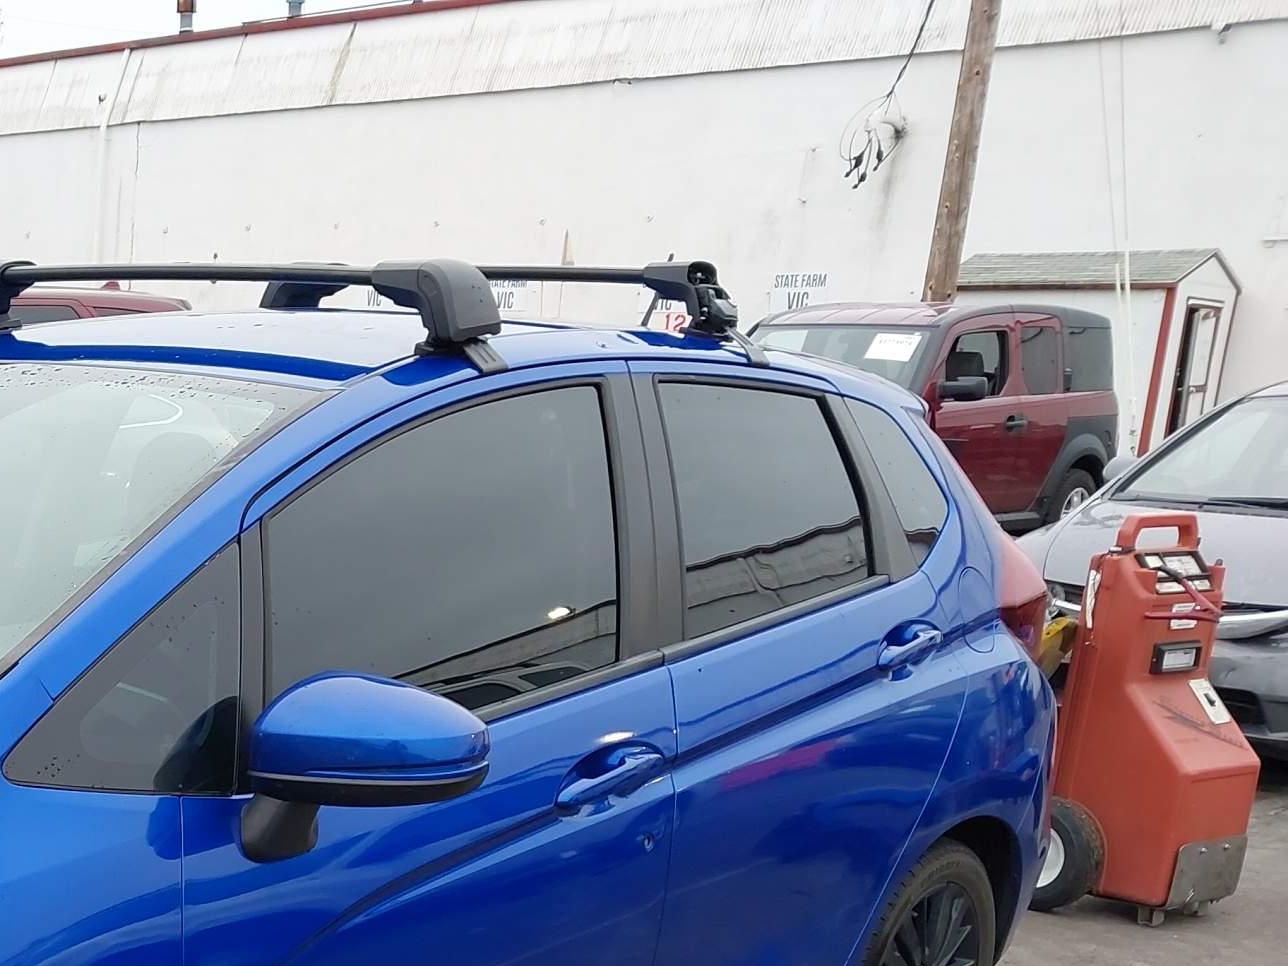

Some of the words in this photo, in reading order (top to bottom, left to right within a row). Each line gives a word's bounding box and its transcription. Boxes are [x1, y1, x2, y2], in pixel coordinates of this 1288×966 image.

[774, 273, 800, 288] STATE
[801, 273, 827, 288] FARM
[496, 291, 514, 309] VIC
[787, 291, 809, 310] VIC
[665, 312, 686, 332] 12
